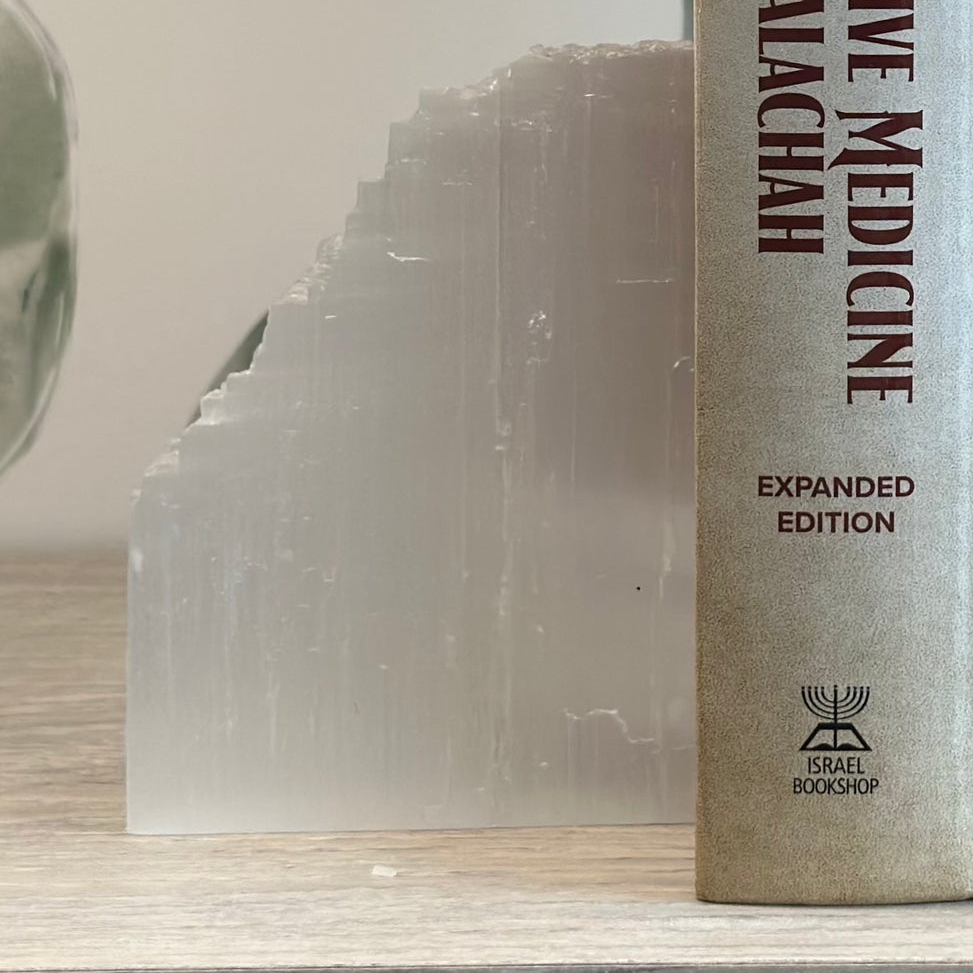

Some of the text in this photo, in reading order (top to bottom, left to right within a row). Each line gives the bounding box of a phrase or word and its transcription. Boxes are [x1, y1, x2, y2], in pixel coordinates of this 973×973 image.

[757, 475, 915, 498] EXPANDED
[776, 511, 895, 533] EDITION
[807, 757, 865, 774] ISRAEL
[793, 778, 879, 795] BOOKSHOP
